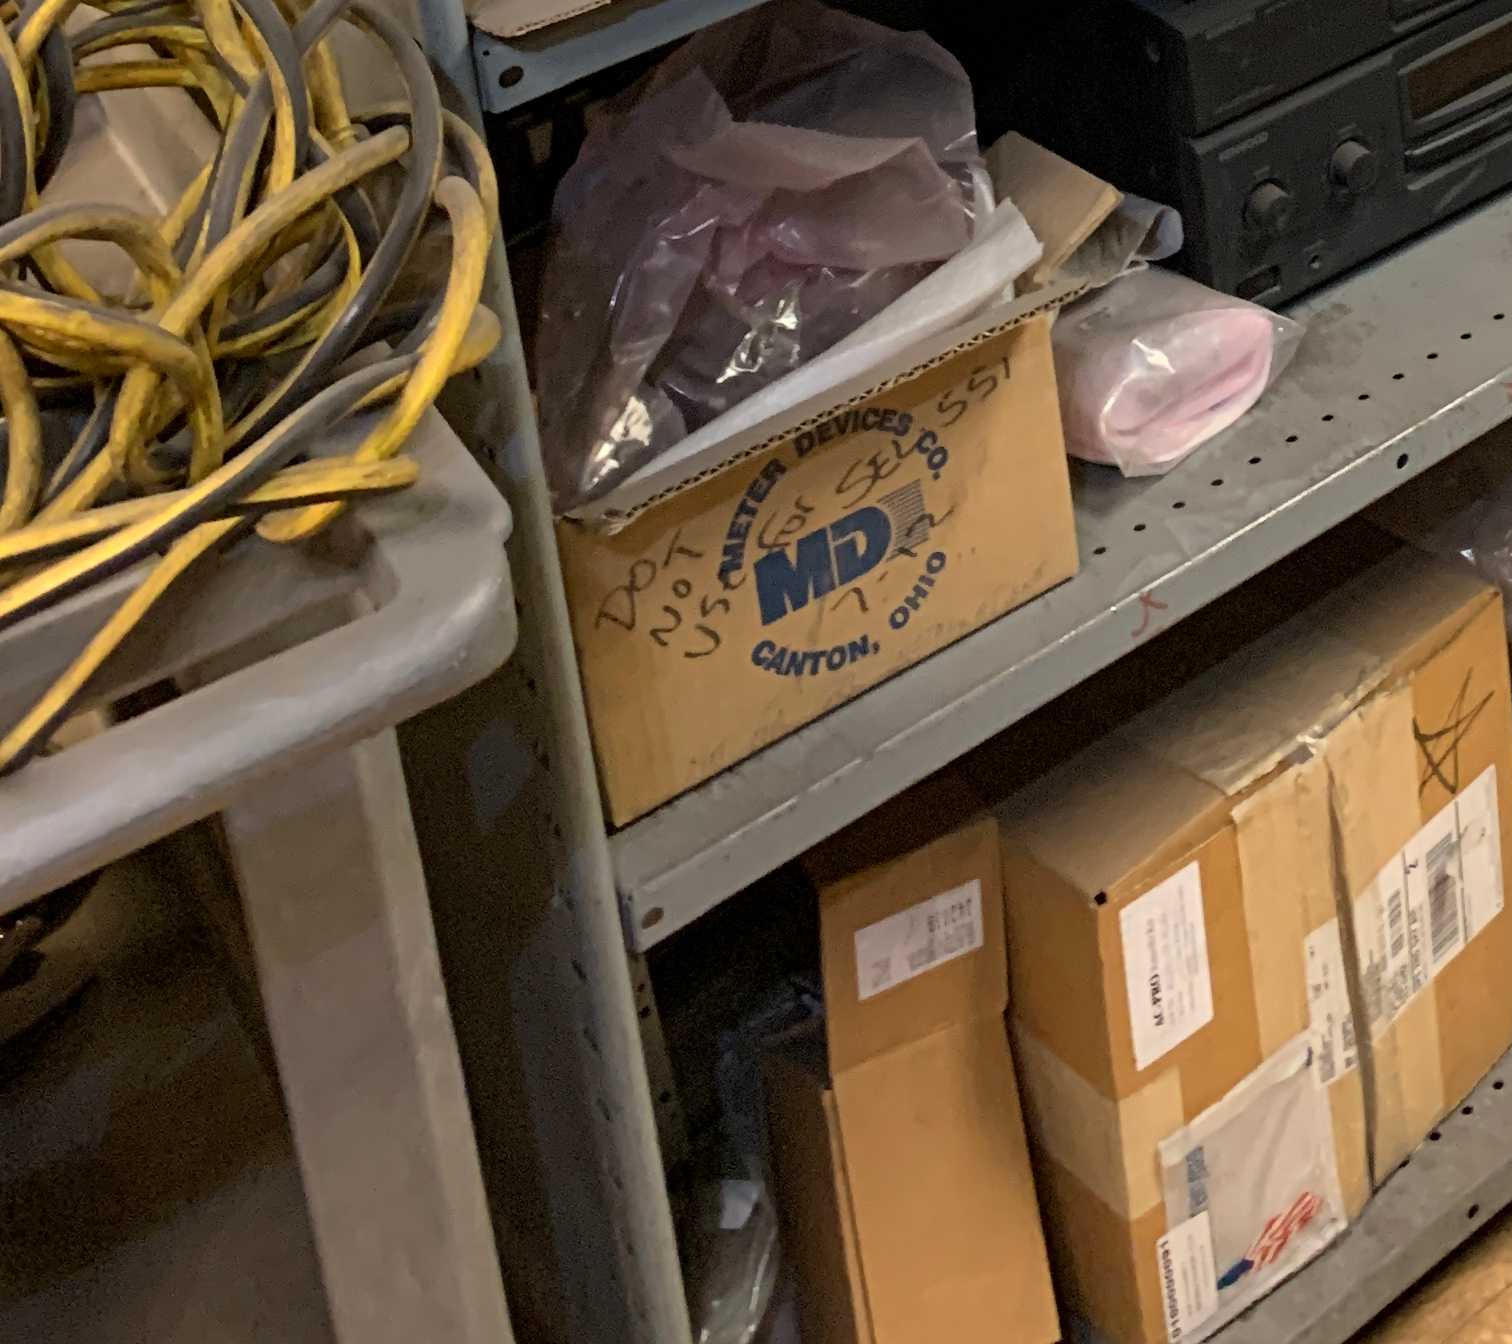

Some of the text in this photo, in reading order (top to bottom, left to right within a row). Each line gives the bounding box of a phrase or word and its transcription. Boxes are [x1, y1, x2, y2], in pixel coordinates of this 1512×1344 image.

[719, 408, 948, 576] METER DEVICES CO.
[751, 551, 946, 676] CANTON, OHIO
[753, 506, 892, 626] MD
